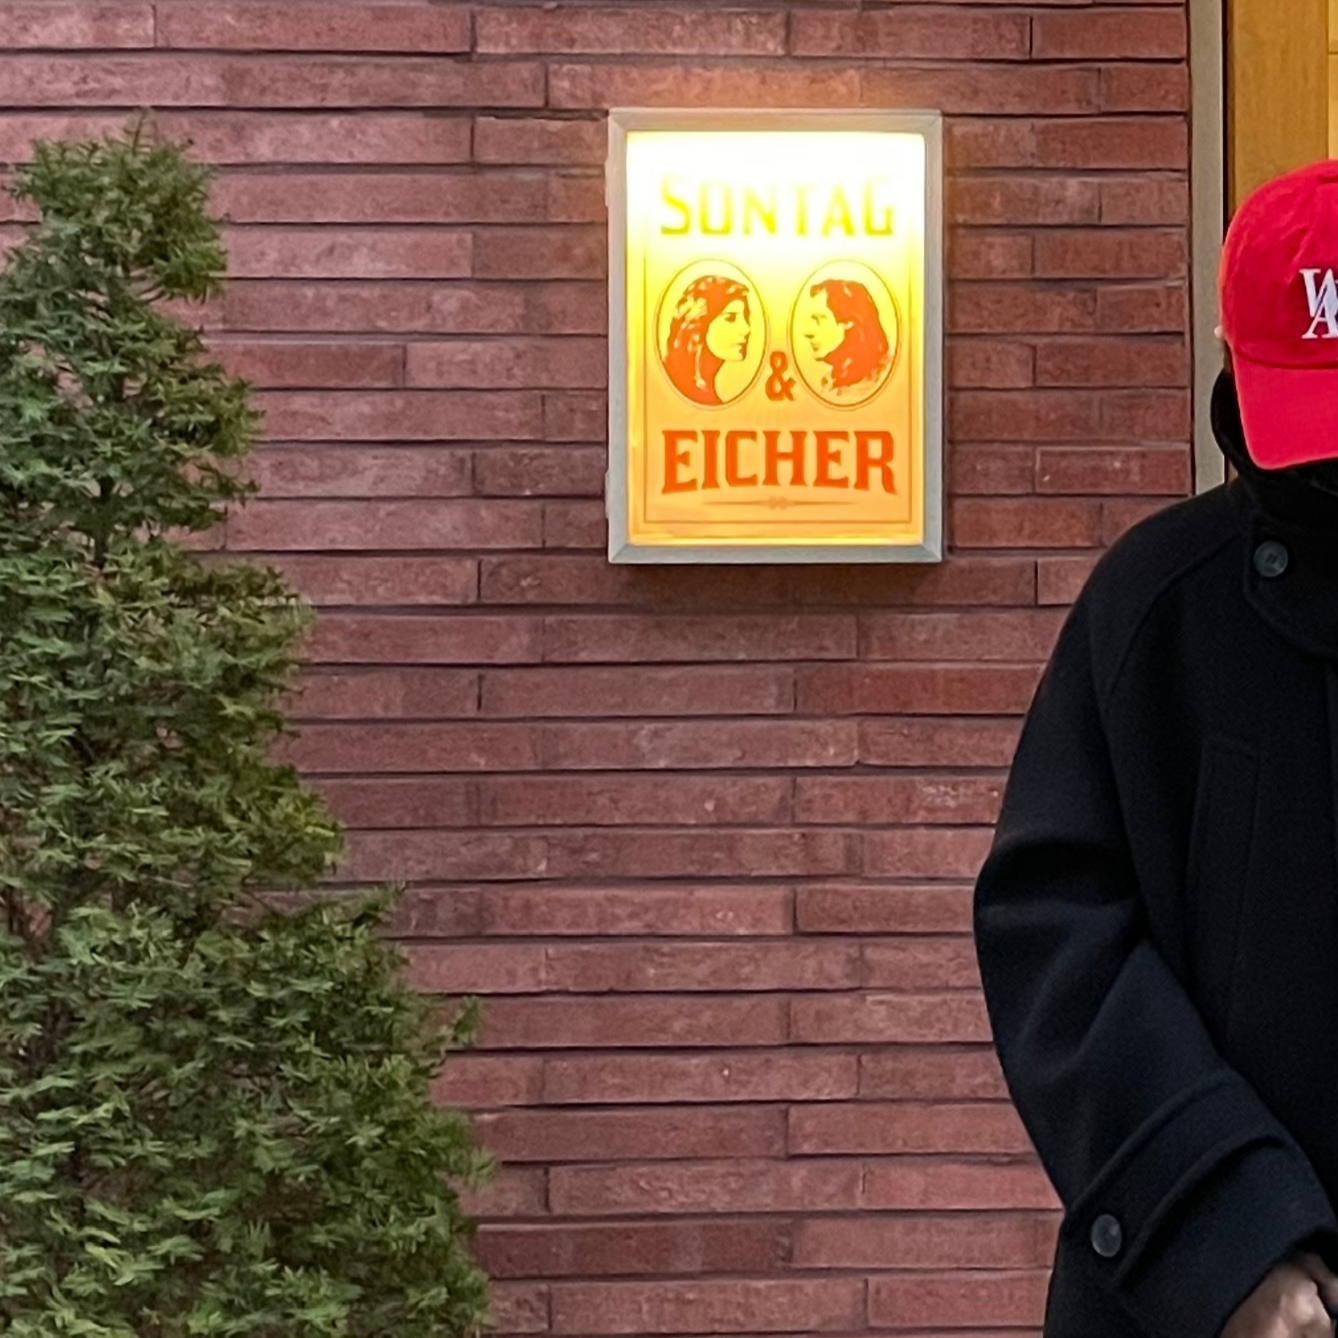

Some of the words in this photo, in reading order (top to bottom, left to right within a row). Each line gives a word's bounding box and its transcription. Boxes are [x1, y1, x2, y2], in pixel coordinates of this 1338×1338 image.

[661, 174, 895, 237] SONTAG
[765, 351, 796, 401] &
[661, 429, 898, 495] EICHER
